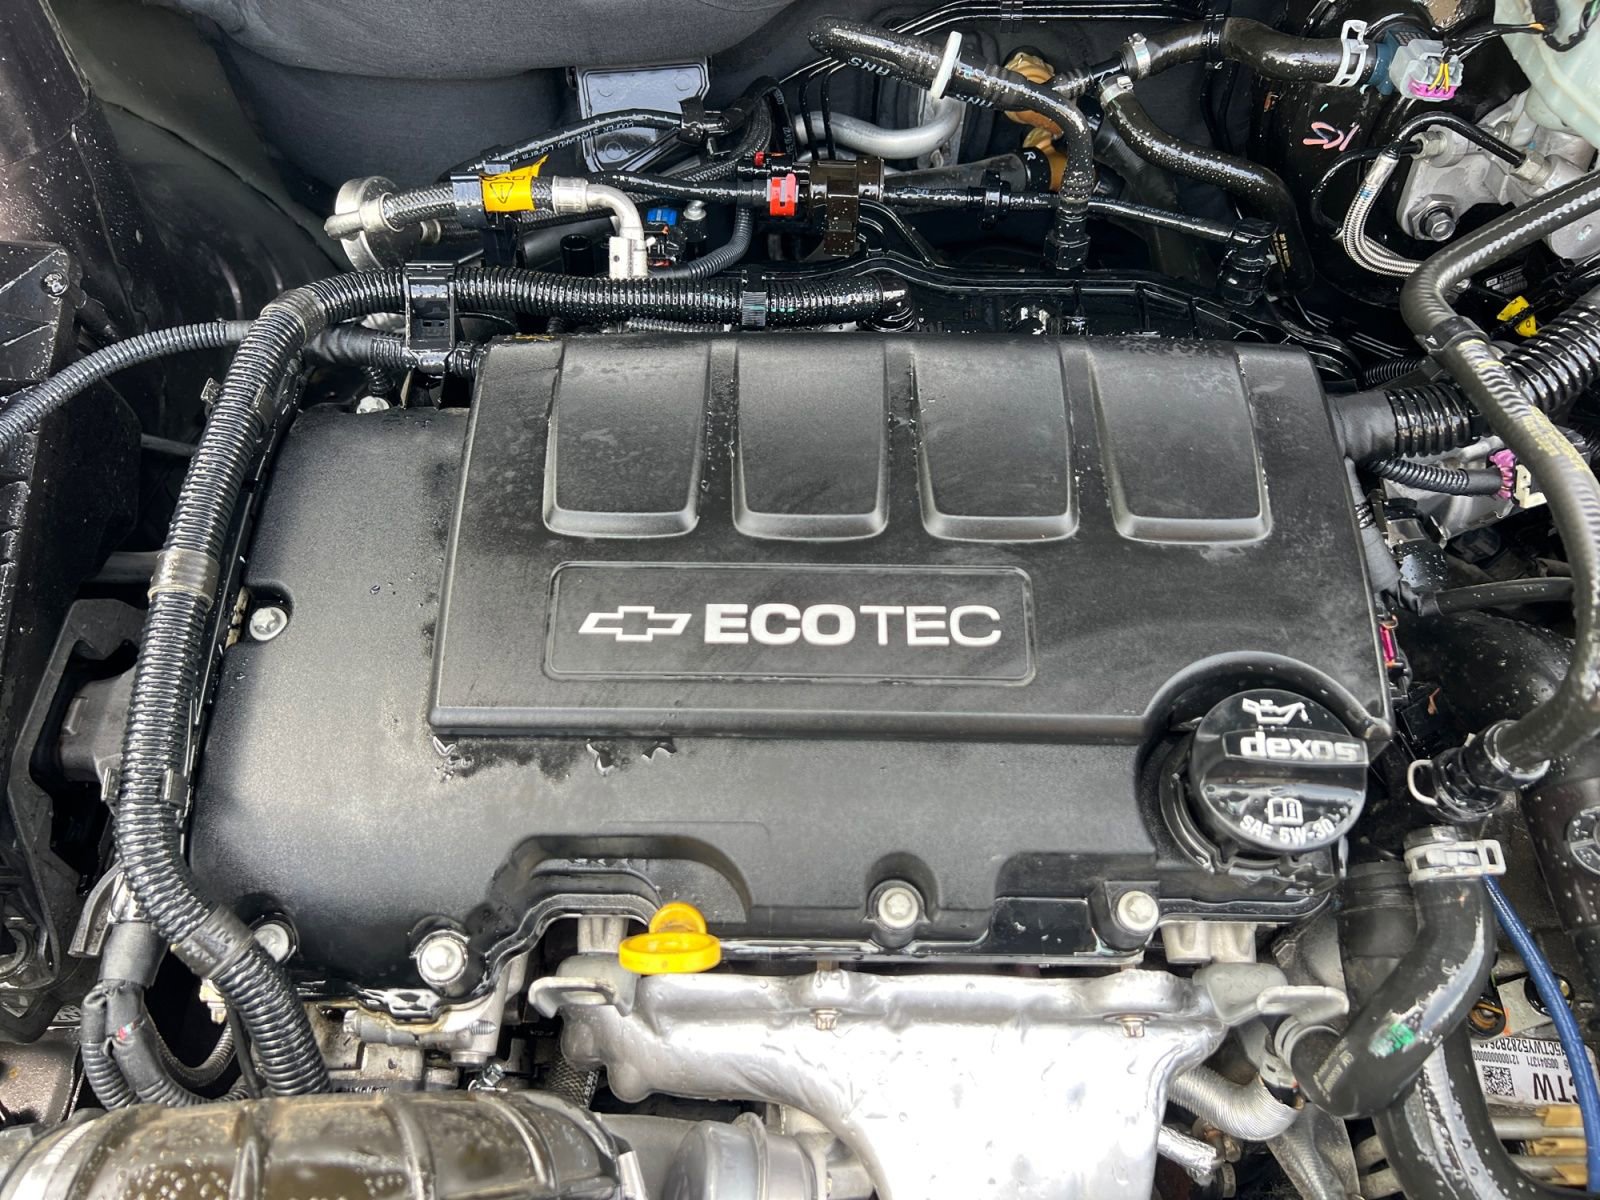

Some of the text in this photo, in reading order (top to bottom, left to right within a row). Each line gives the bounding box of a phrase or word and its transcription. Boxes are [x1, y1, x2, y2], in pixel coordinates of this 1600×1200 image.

[704, 603, 1002, 646] ECOTEC
[1240, 731, 1360, 761] dexos
[1239, 815, 1336, 846] SAE 5W-30
